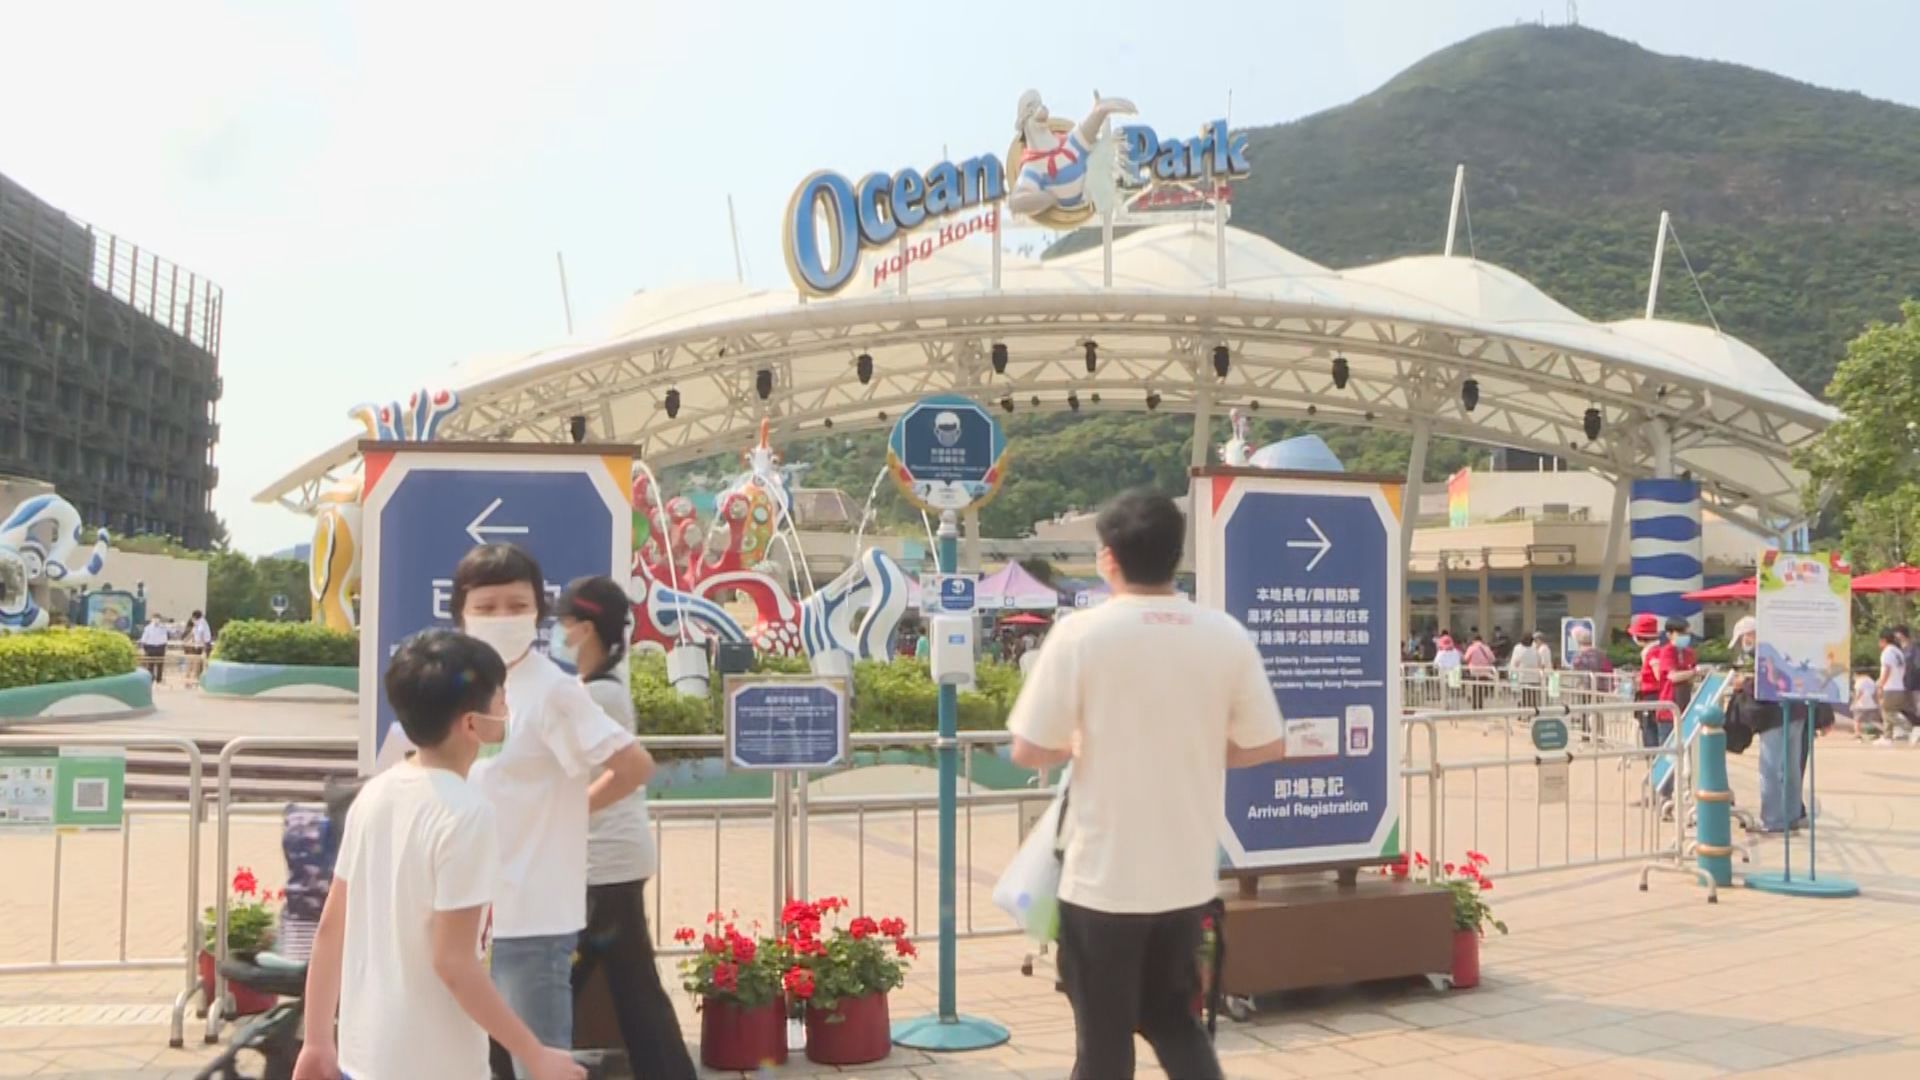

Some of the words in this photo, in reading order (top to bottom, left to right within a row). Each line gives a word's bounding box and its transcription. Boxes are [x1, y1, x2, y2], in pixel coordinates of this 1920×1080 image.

[784, 152, 1005, 295] Ocean
[1117, 118, 1250, 188] Park
[873, 235, 933, 288] Hong
[938, 209, 998, 250] Kong
[1248, 806, 1290, 819] Arrival
[1294, 801, 1368, 818] Registration
[1274, 777, 1344, 799] 即場登記
